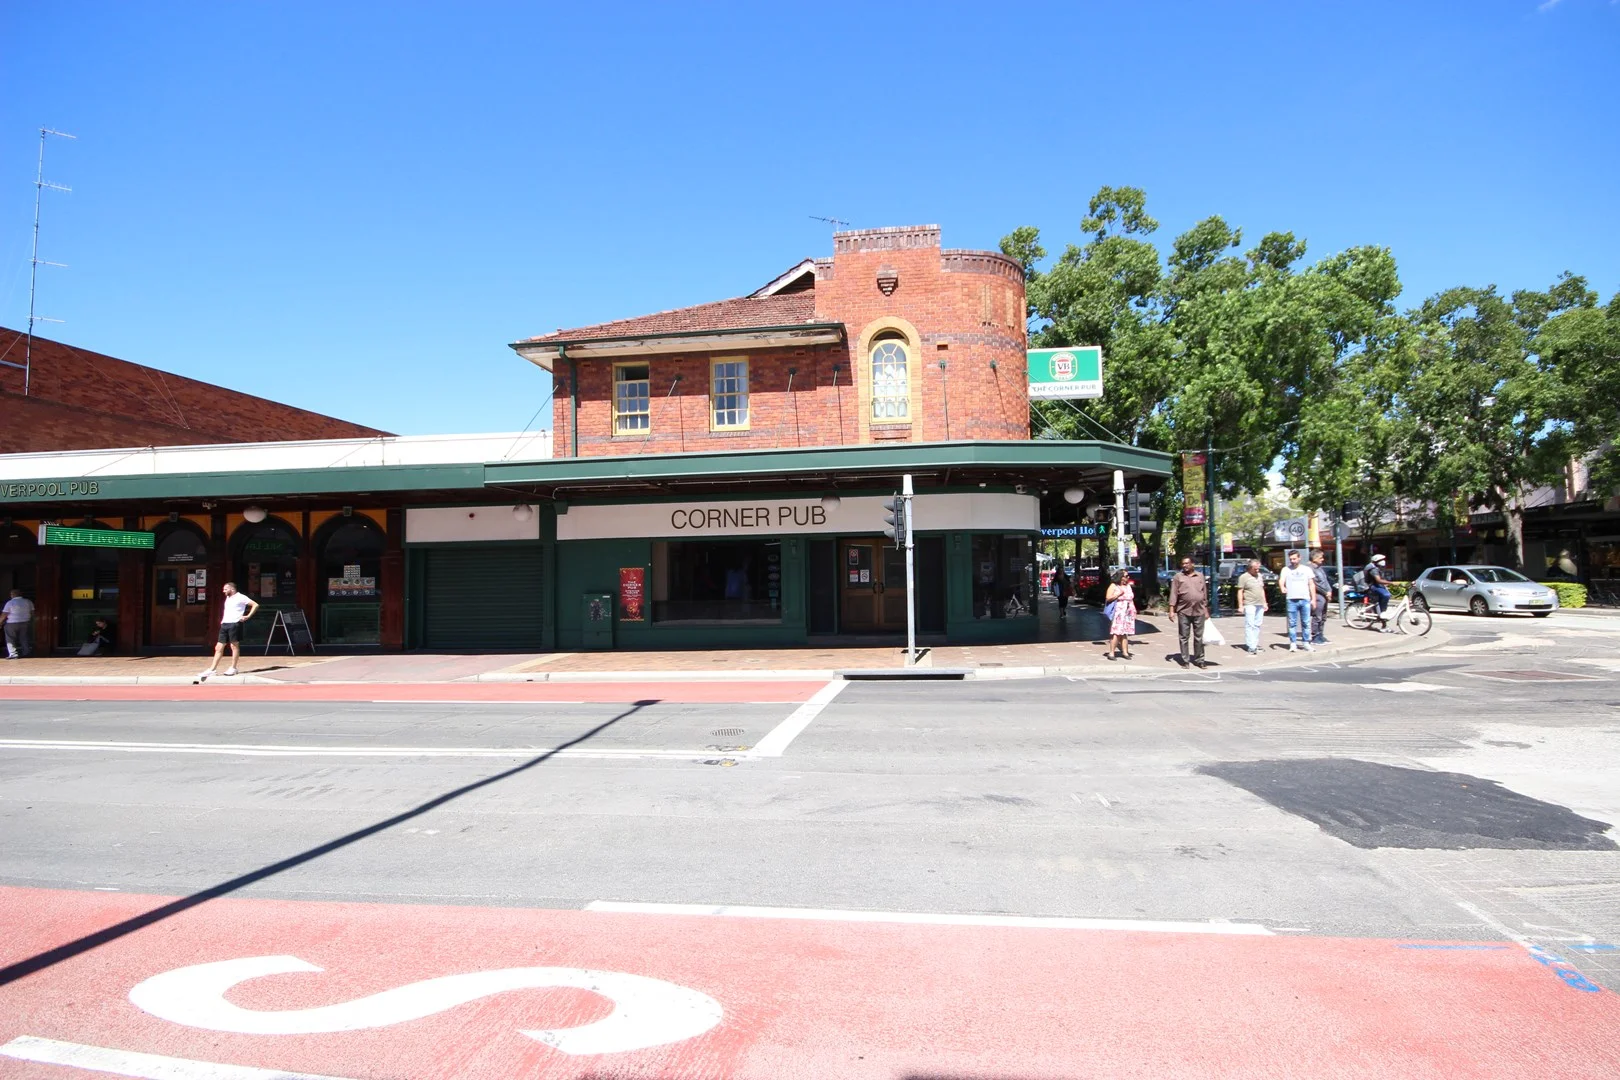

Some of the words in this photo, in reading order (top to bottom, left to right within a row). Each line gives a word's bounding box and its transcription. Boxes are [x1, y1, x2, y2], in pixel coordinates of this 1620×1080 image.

[70, 481, 99, 496] PUB
[671, 508, 770, 530] CORNER
[778, 506, 827, 526] PUB
[1291, 526, 1303, 534] 40
[54, 532, 85, 542] NRL
[88, 533, 119, 544] Lives
[122, 536, 148, 545] Here
[129, 954, 724, 1056] S
